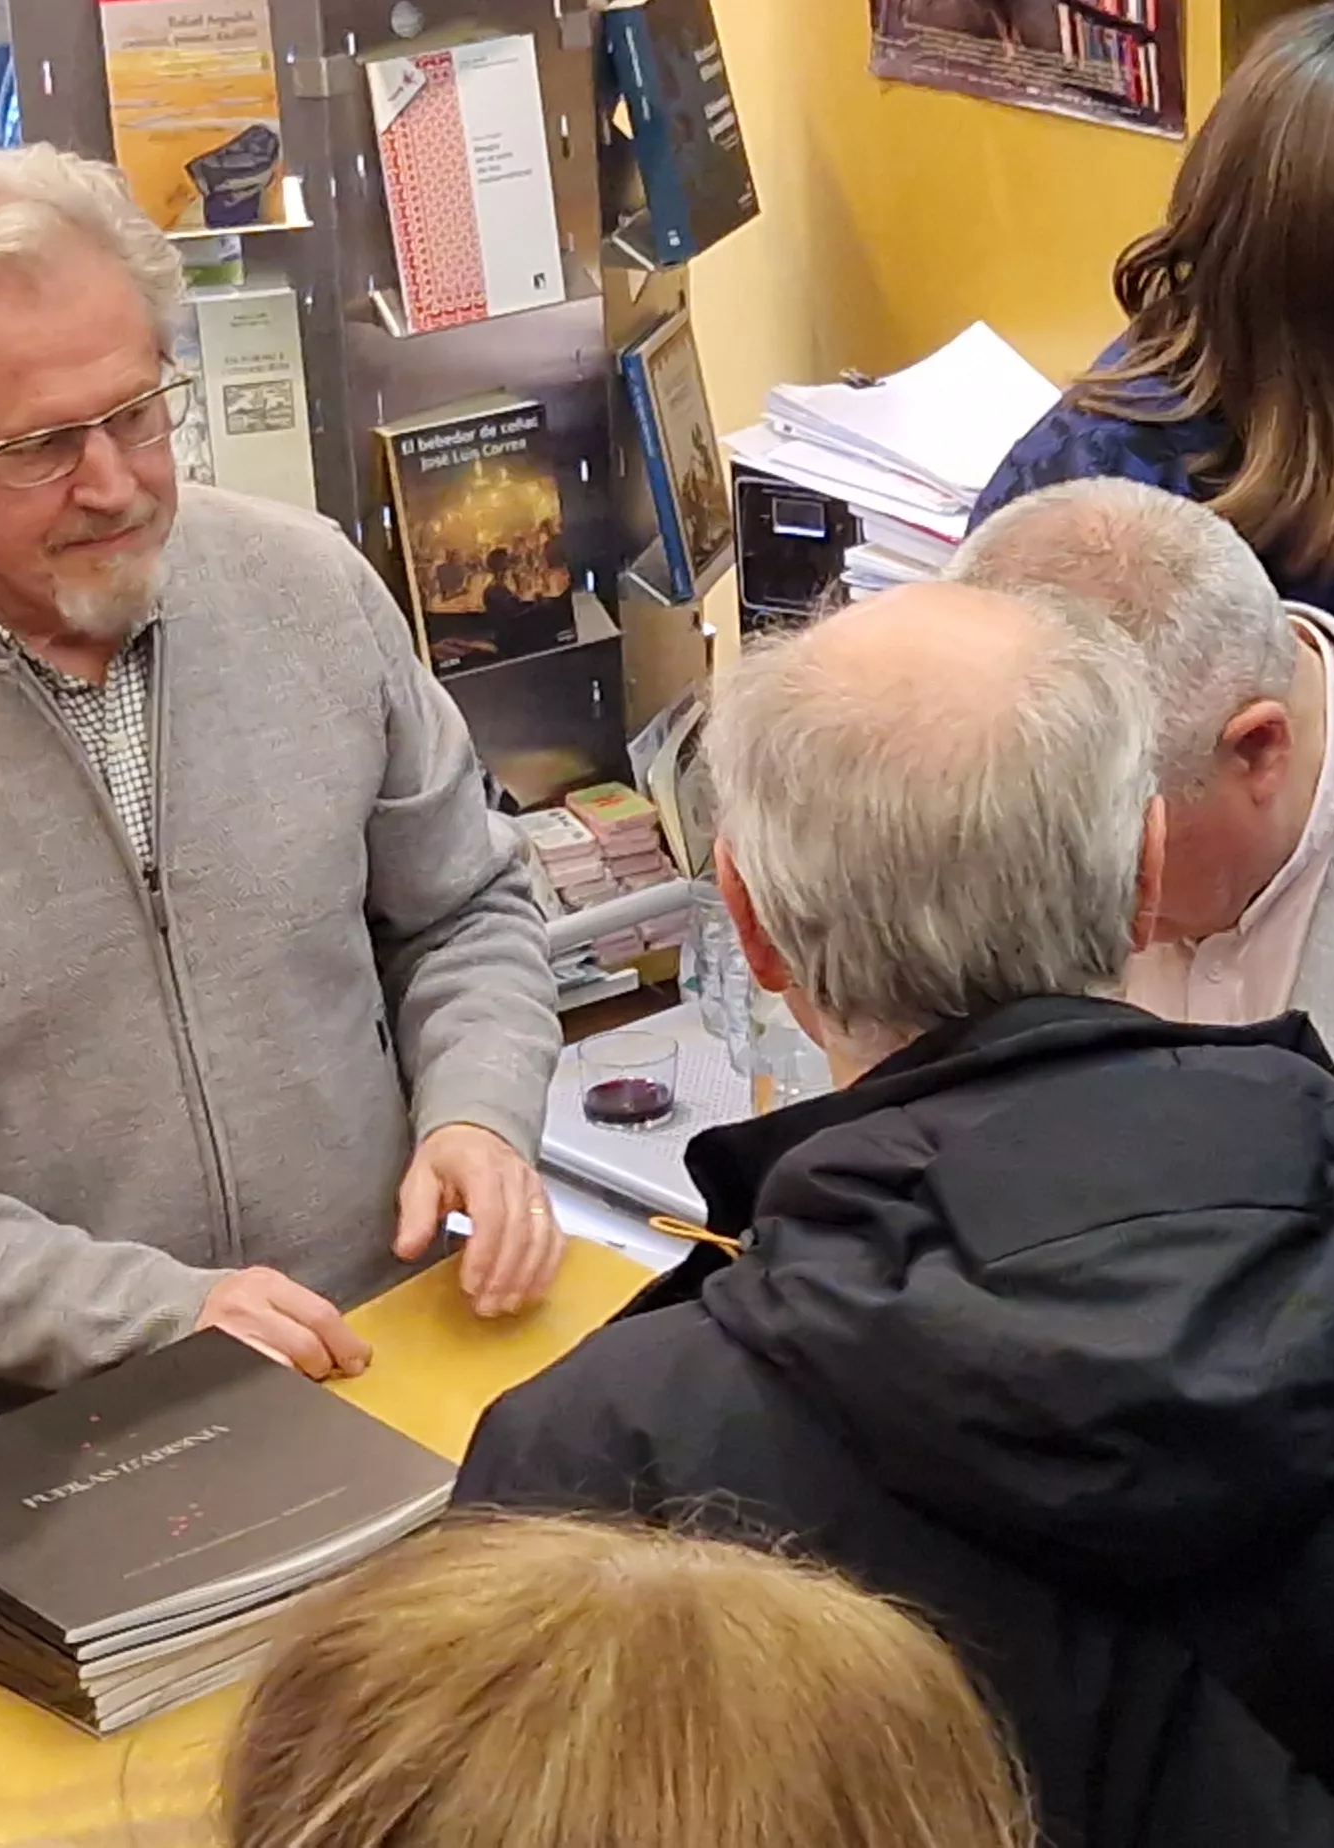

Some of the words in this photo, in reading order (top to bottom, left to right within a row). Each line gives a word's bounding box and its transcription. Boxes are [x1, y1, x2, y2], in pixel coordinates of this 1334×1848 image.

[401, 438, 415, 455] El
[418, 428, 476, 451] bebedor
[479, 424, 497, 439] de
[420, 452, 450, 473] José
[482, 438, 527, 457] Correa
